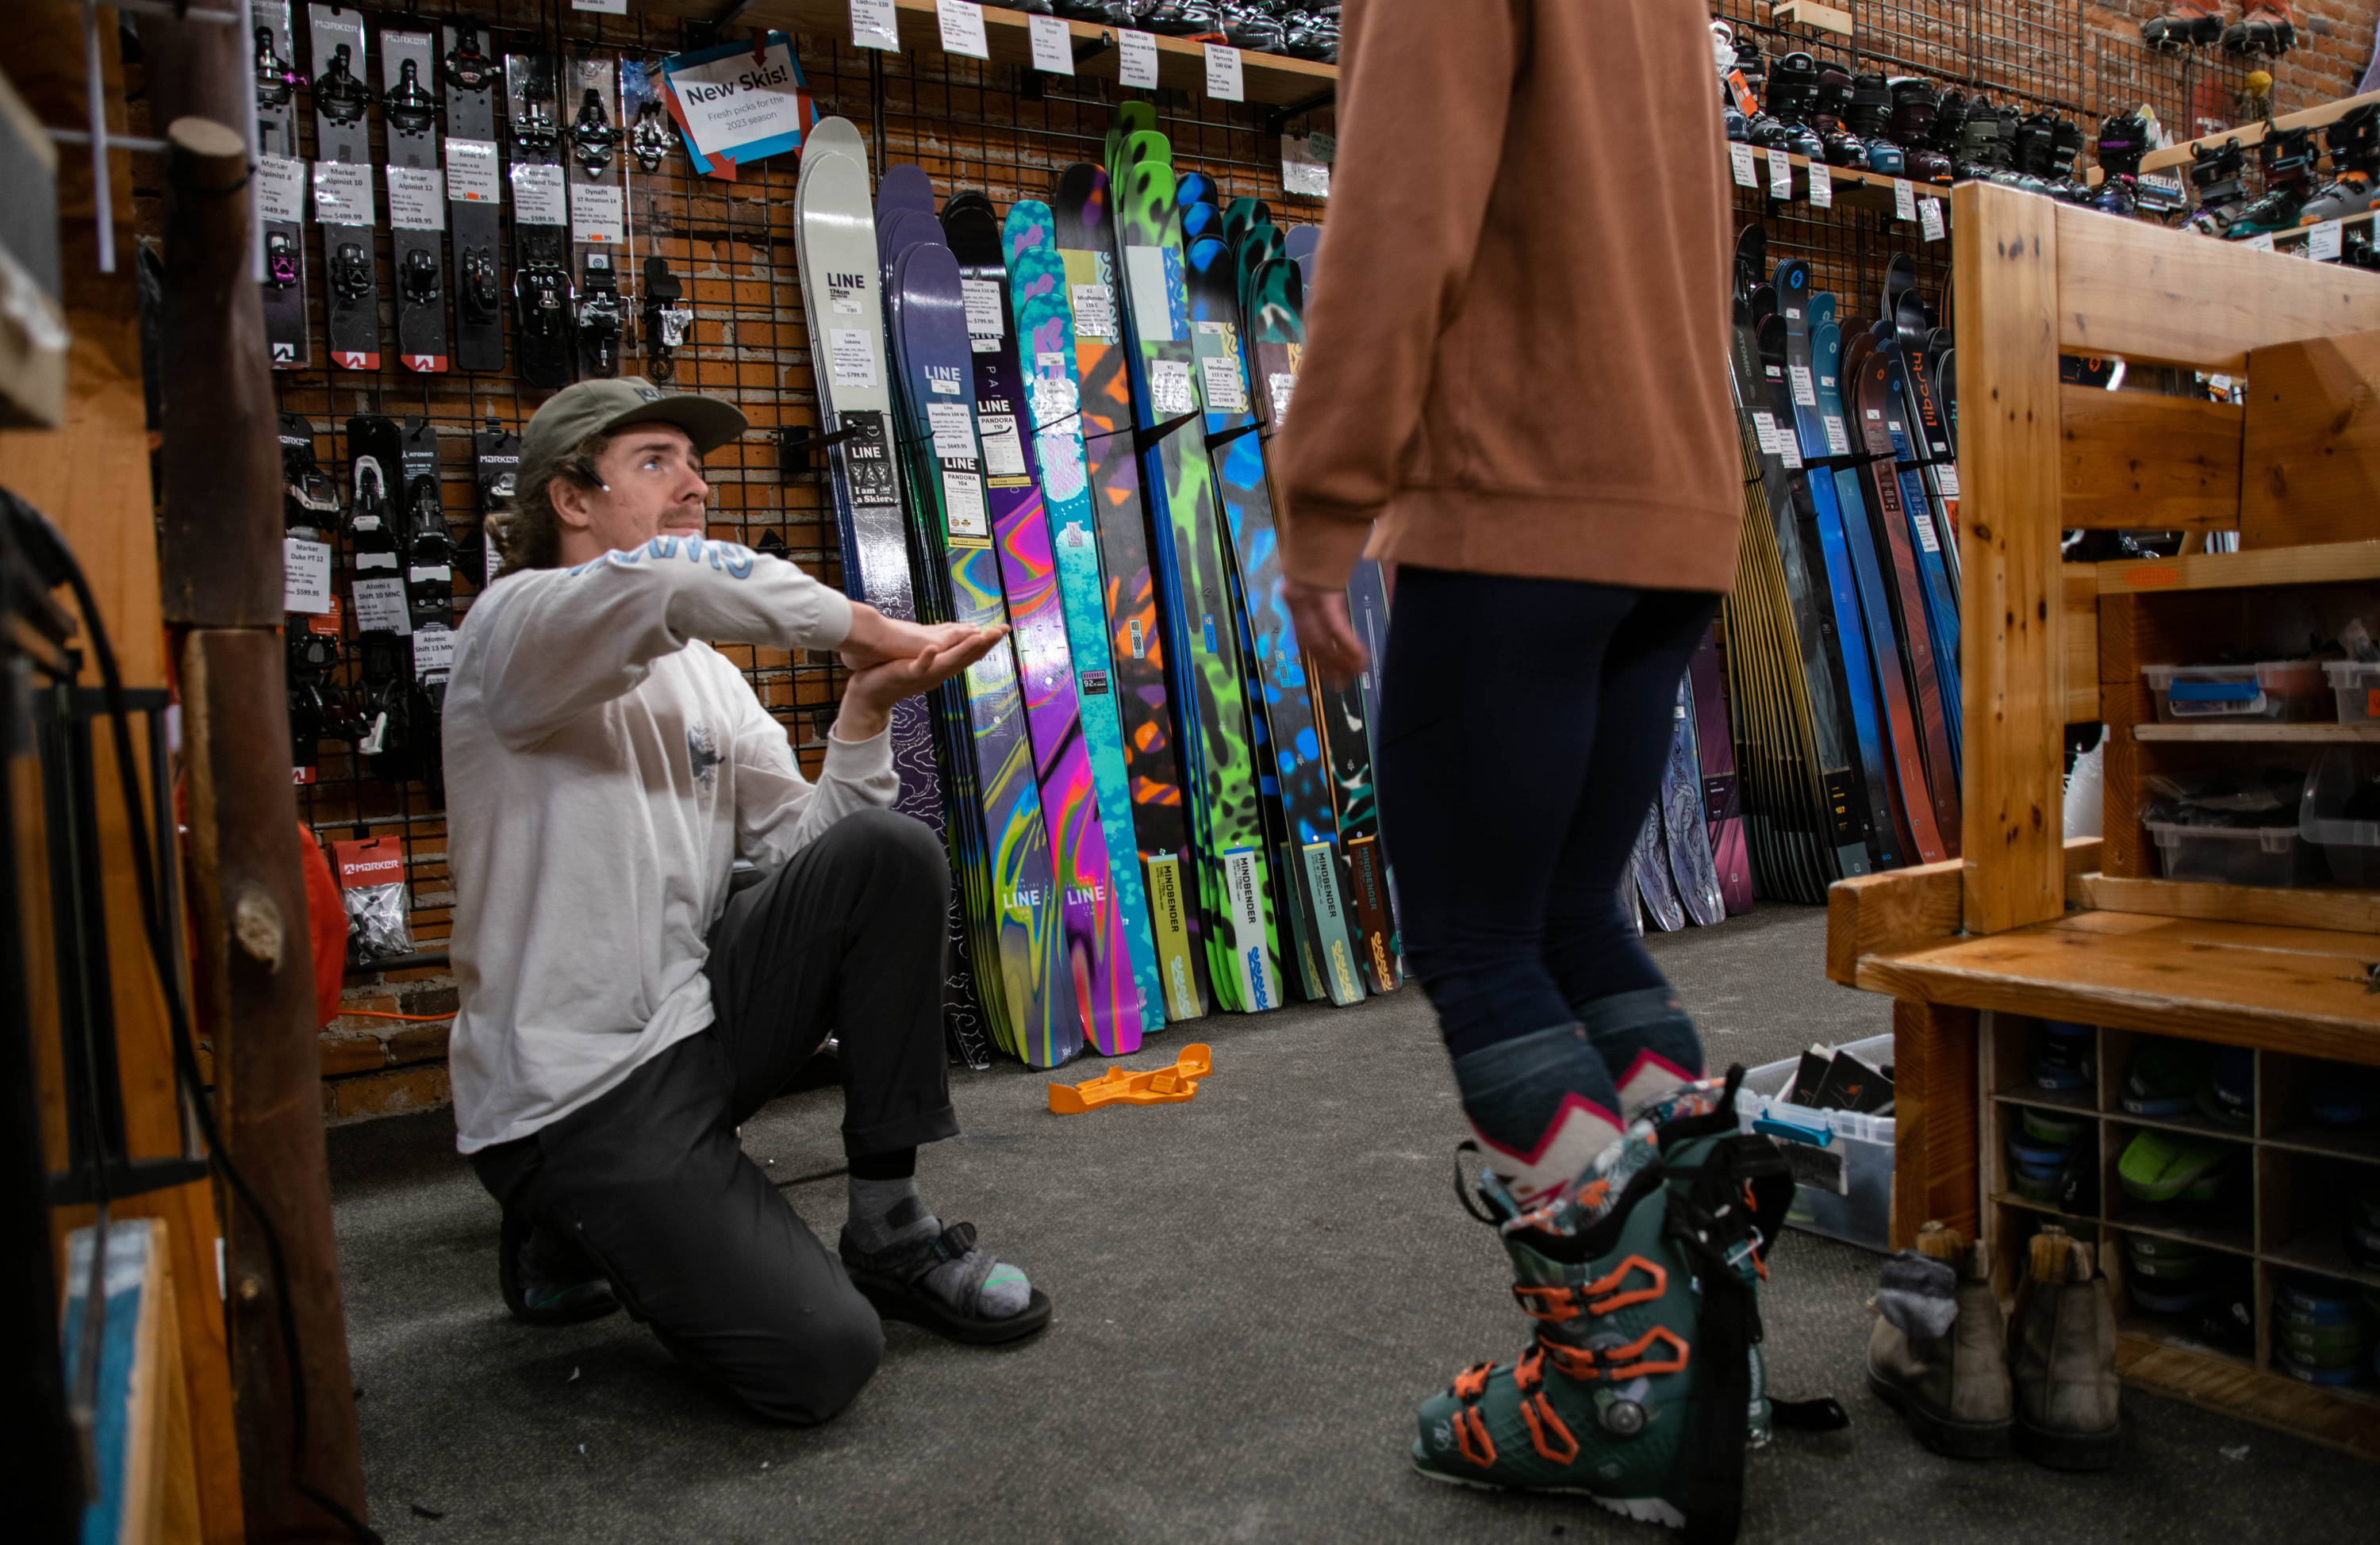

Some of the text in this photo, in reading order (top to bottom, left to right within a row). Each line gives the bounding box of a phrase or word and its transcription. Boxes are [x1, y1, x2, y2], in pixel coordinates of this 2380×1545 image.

[315, 20, 359, 33] MARKER
[386, 34, 427, 46] MARKER
[686, 65, 788, 106] New Skis!
[708, 95, 785, 121] Fresh picks for the
[726, 112, 777, 131] 2023 season
[827, 273, 865, 289] LINE
[1738, 329, 1752, 377] ATOMIC
[925, 365, 962, 381] LINE
[978, 400, 1010, 412] LINE
[480, 455, 519, 464] MARKER
[852, 446, 881, 458] LINE
[945, 458, 976, 470] LINE
[356, 860, 398, 872] MARKER
[1318, 853, 1337, 918] MINDBENDER
[1362, 847, 1377, 911] MINDBENDER
[1003, 890, 1040, 909] LINE
[1067, 886, 1106, 905] LINE
[1164, 866, 1179, 933] MINDBENDER
[1241, 857, 1256, 924] MINDBENDER
